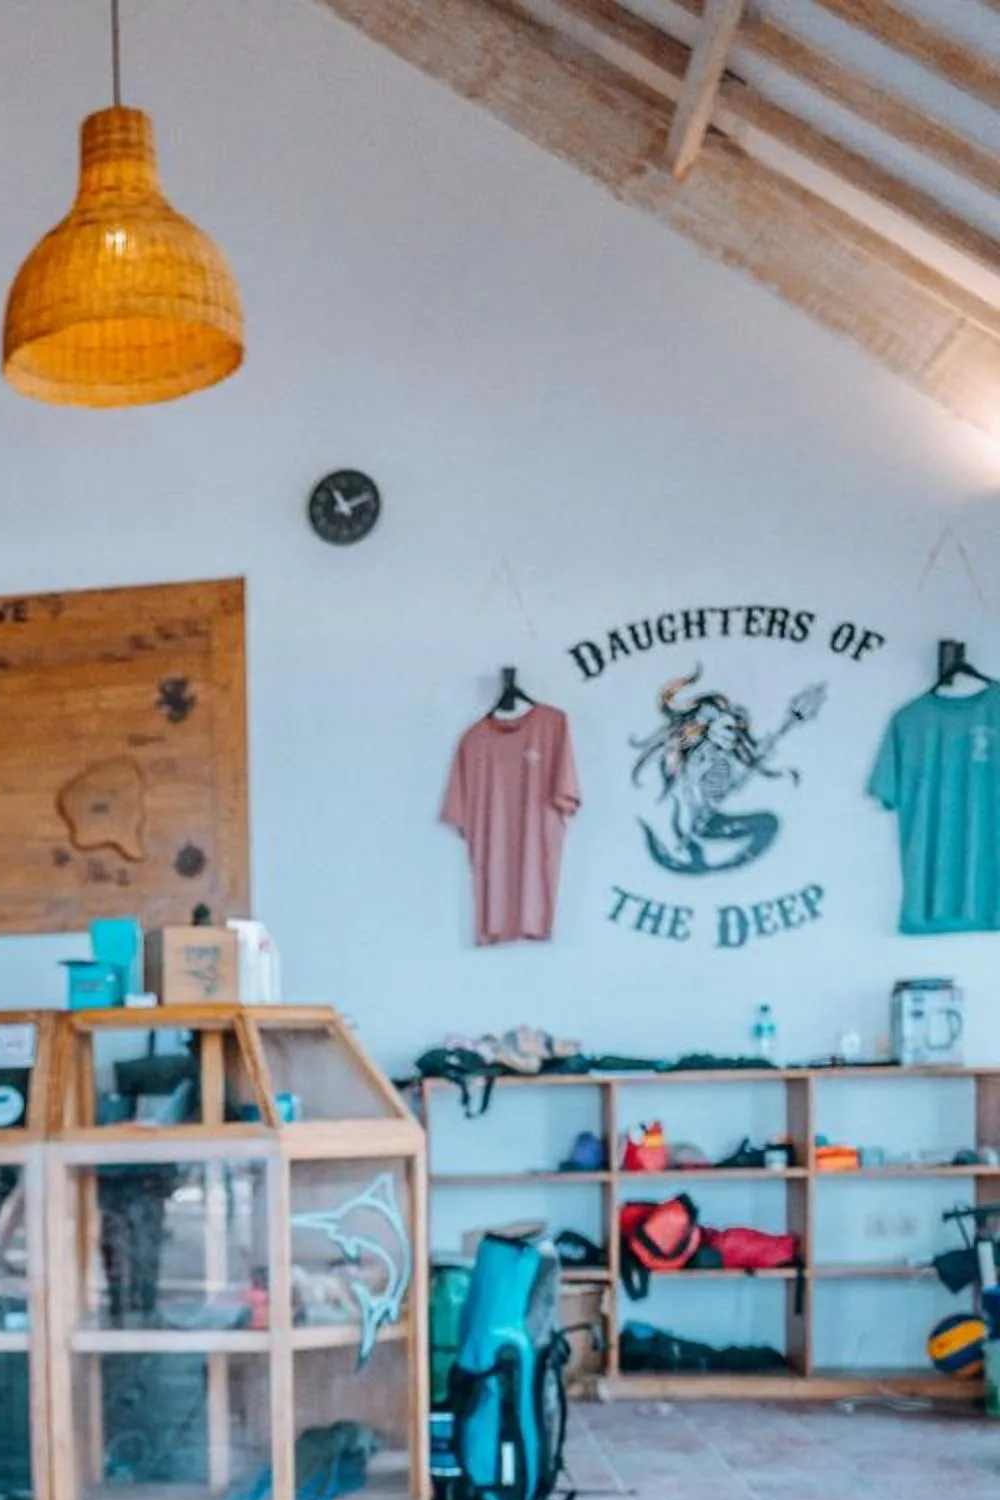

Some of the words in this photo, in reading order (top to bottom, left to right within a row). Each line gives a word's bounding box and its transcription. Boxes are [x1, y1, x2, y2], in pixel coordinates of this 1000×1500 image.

[568, 604, 817, 682] DAUGHTERS
[829, 621, 886, 663] OF
[605, 885, 694, 942] THE
[715, 883, 826, 949] DEEP
